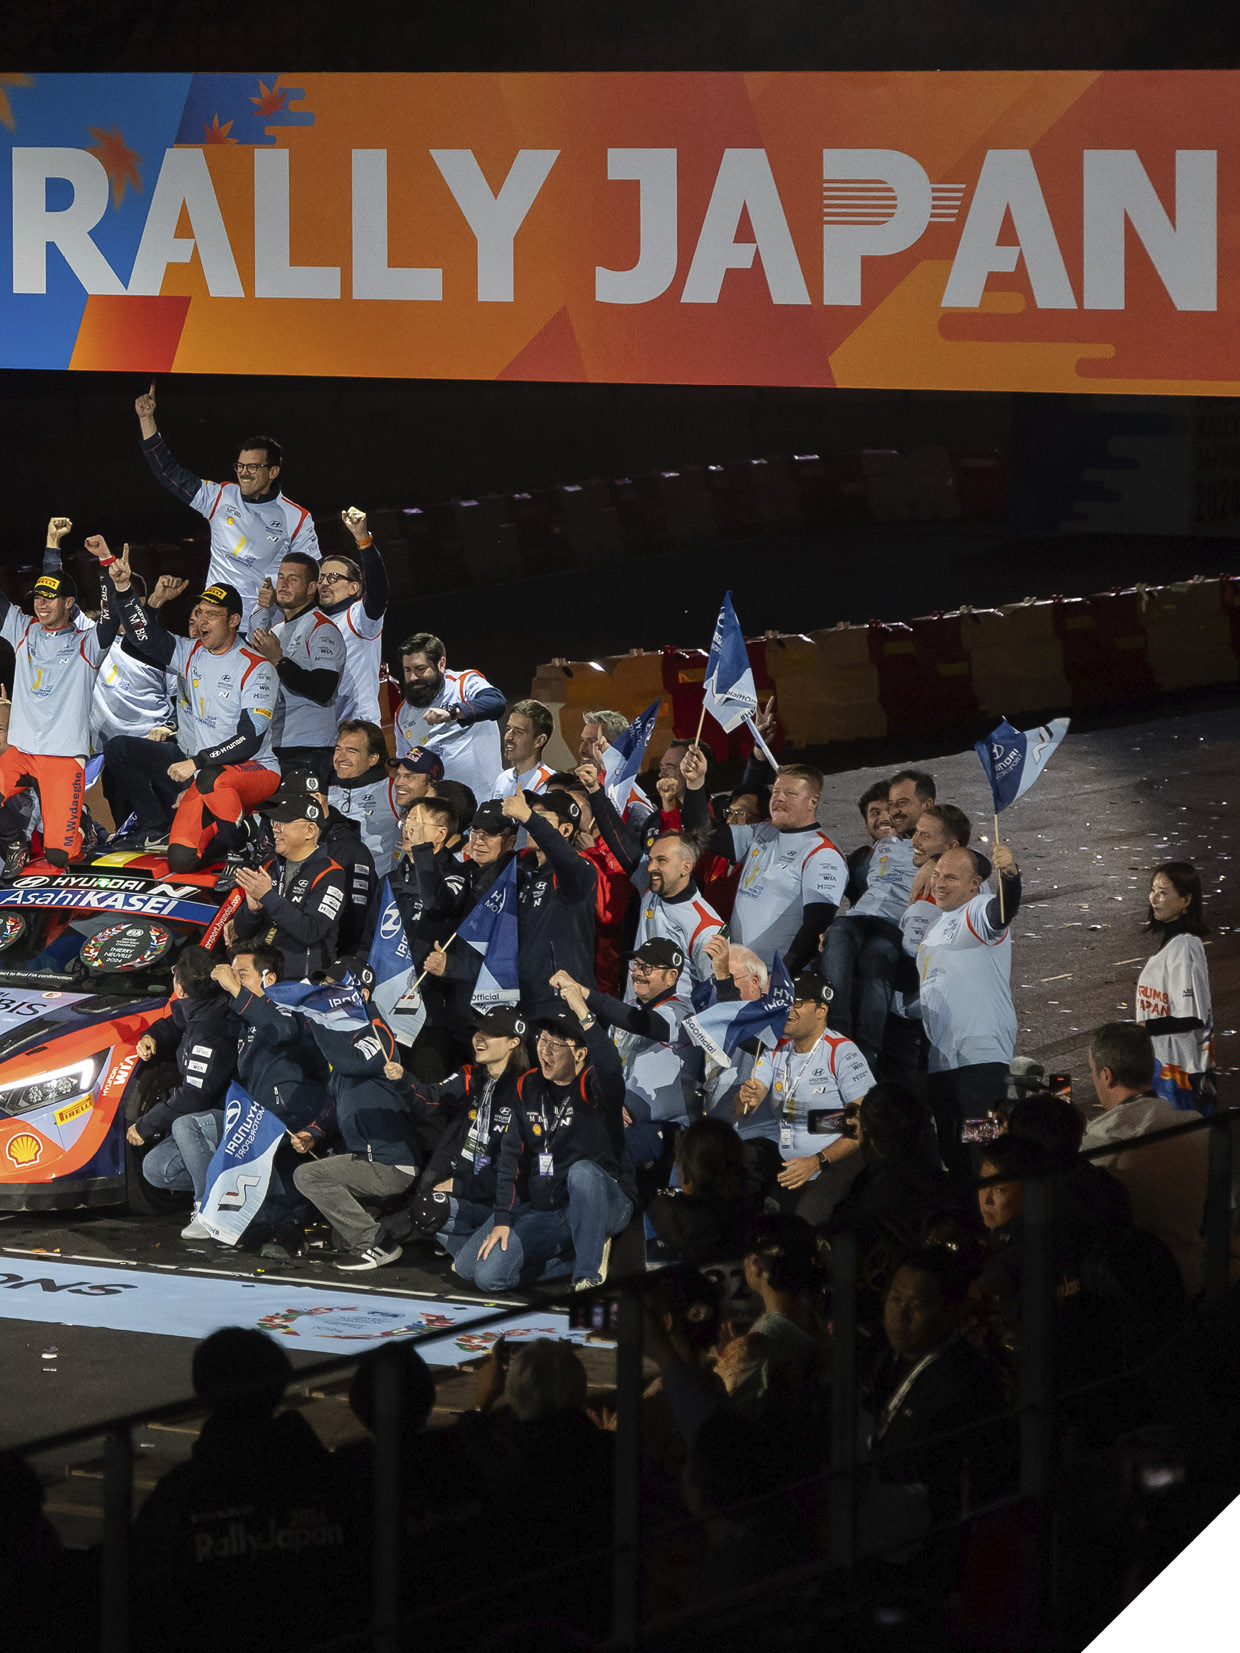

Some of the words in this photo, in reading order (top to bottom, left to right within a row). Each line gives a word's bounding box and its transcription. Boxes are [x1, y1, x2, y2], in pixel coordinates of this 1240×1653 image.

[12, 146, 562, 303] RALLY
[595, 147, 1218, 312] JAPAN
[128, 613, 149, 642] MOBIS
[63, 771, 83, 848] M.Wydaeghe
[52, 876, 146, 892] HYUNDAI
[0, 889, 179, 915] AsahiKASEI
[1139, 999, 1171, 1017] APAN
[102, 1066, 119, 1097] HYUNDAI
[59, 1097, 93, 1122] PIRELLI
